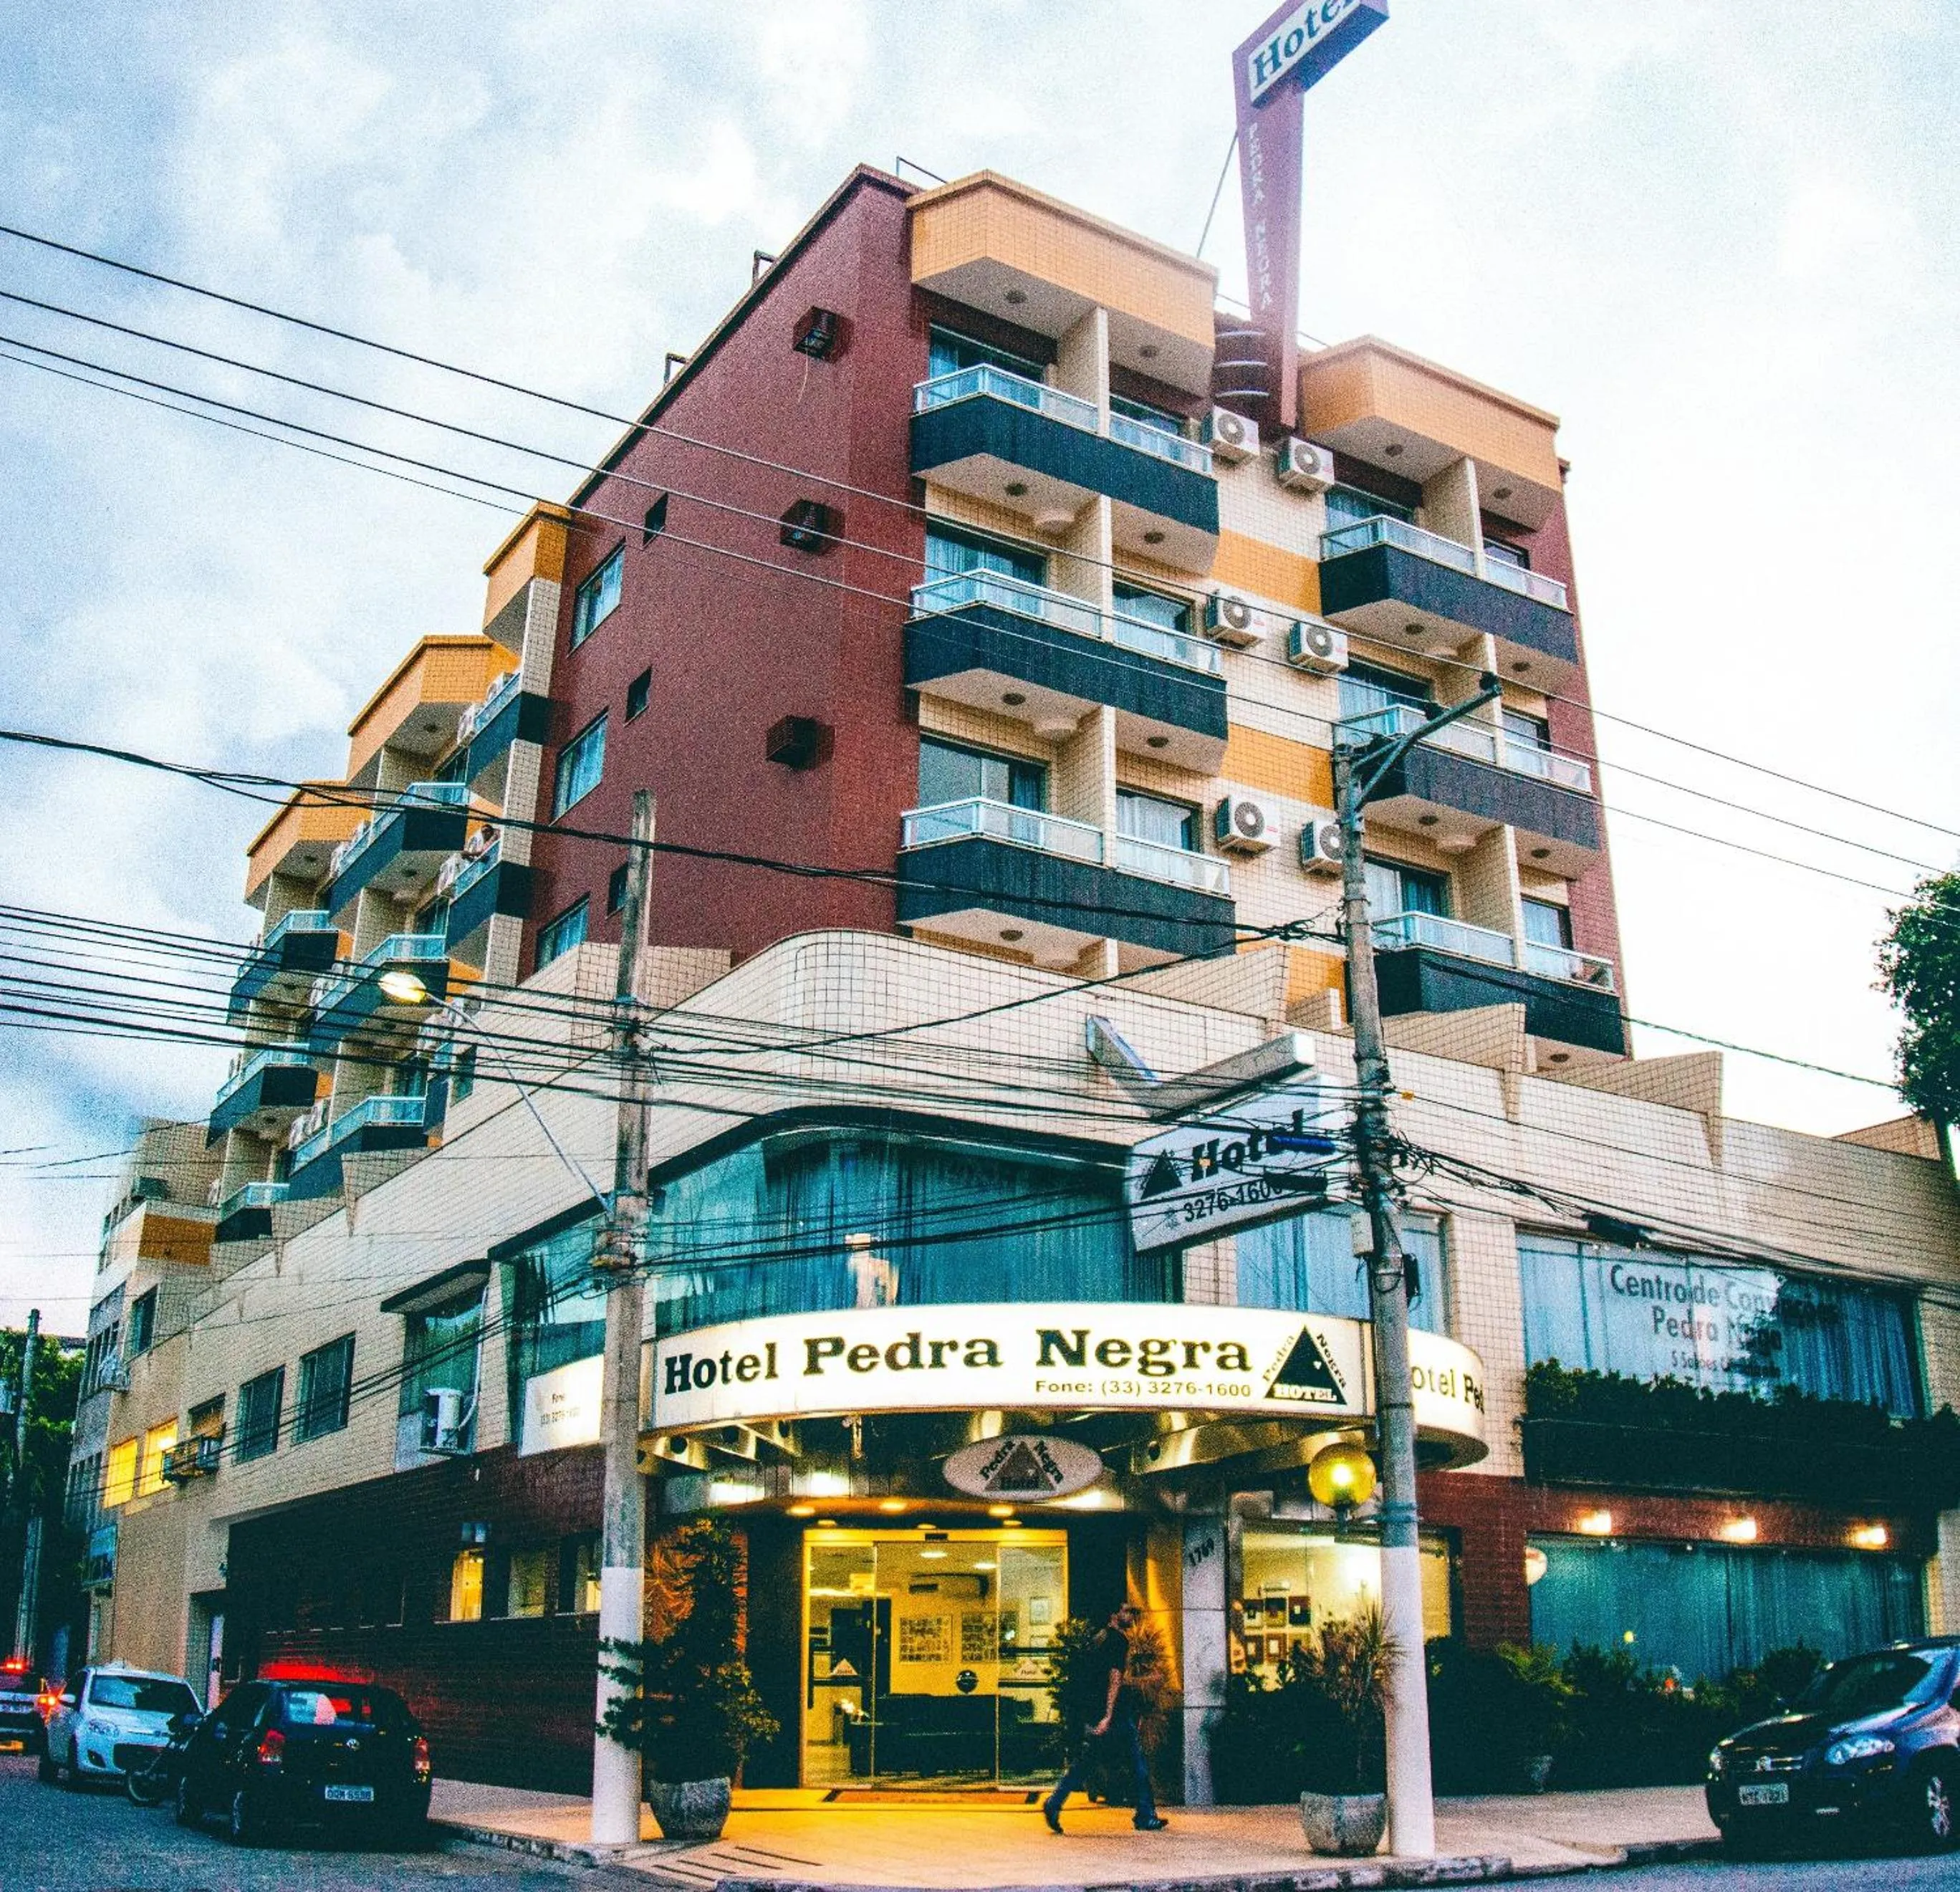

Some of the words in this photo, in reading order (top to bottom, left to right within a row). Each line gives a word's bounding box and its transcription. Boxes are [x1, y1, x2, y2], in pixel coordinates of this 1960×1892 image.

[1254, 0, 1355, 89] Hote
[1611, 1264, 1687, 1304] Centro
[1694, 1274, 1719, 1307] de
[1652, 1305, 1719, 1341] Pedra
[664, 1343, 779, 1395] Hotel
[803, 1331, 1004, 1375] Pedra
[1034, 1329, 1253, 1378] Negra
[1317, 1333, 1346, 1388] Negra
[1411, 1365, 1456, 1398] otel
[1035, 1380, 1093, 1395] Fone:
[1100, 1380, 1141, 1396] (33)
[1148, 1382, 1252, 1398] 3276-1600
[1274, 1383, 1337, 1402] HOTEL
[1034, 1440, 1064, 1484] Negra
